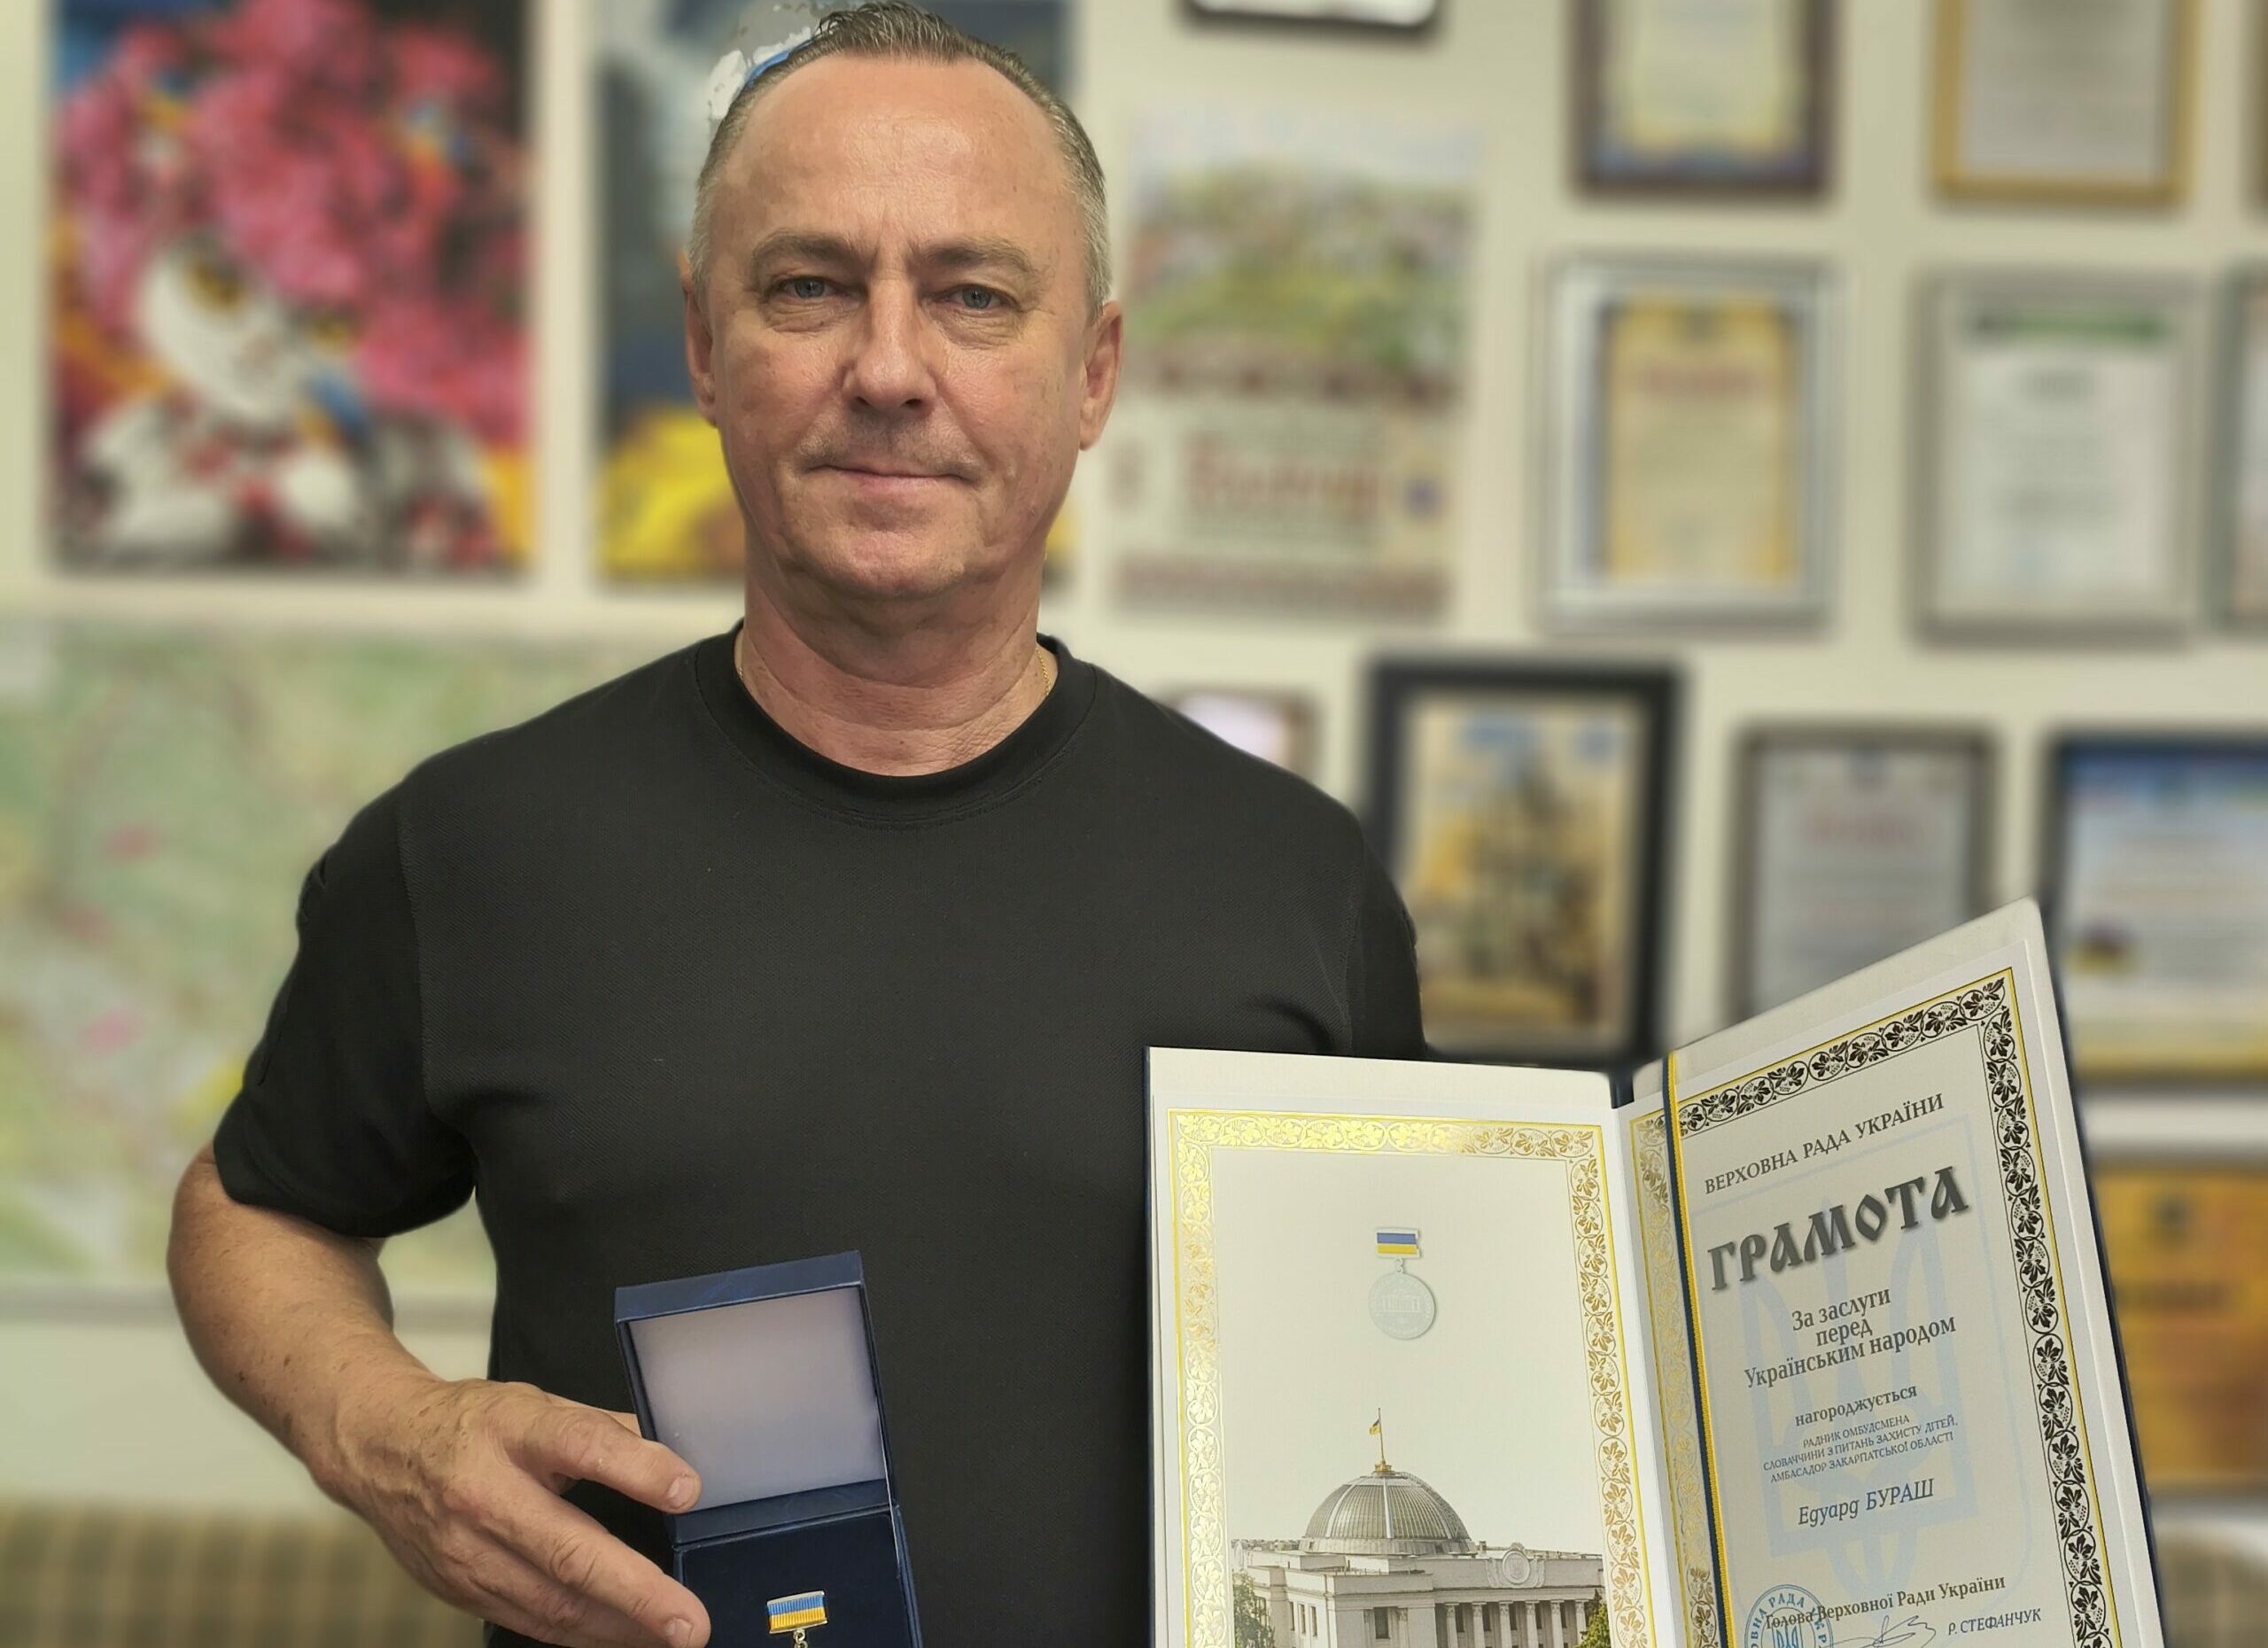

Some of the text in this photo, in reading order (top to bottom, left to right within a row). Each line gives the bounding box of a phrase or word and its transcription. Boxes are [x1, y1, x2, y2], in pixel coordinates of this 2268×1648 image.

[1705, 1093, 1945, 1194] ВЕРХОВНА РАДА УКРАЇНИ
[1707, 1166, 1970, 1291] ГРАМОТА
[1791, 1289, 1891, 1331] За заслуги
[1816, 1318, 1873, 1347] перед
[1744, 1317, 1956, 1388] Українським народом
[1795, 1386, 1917, 1426] нагороджується
[1763, 1449, 1825, 1471] СЛОВАЧЧИНИ
[1835, 1437, 1875, 1455] ПИТАНЬ
[1876, 1425, 1922, 1444] ЗАХИСТУ
[1803, 1415, 1910, 1449] РАДНИК ОМБУДСМЕНА
[1770, 1462, 1827, 1483] АМБАСАДОР
[1910, 1431, 1953, 1450] ОБЛАСТІ
[1798, 1478, 1935, 1528] Едуард БУРАШ
[1766, 1576, 2006, 1630] Голова Верховної Ради України
[1960, 1608, 2041, 1634] СТЕФАНЧУК
